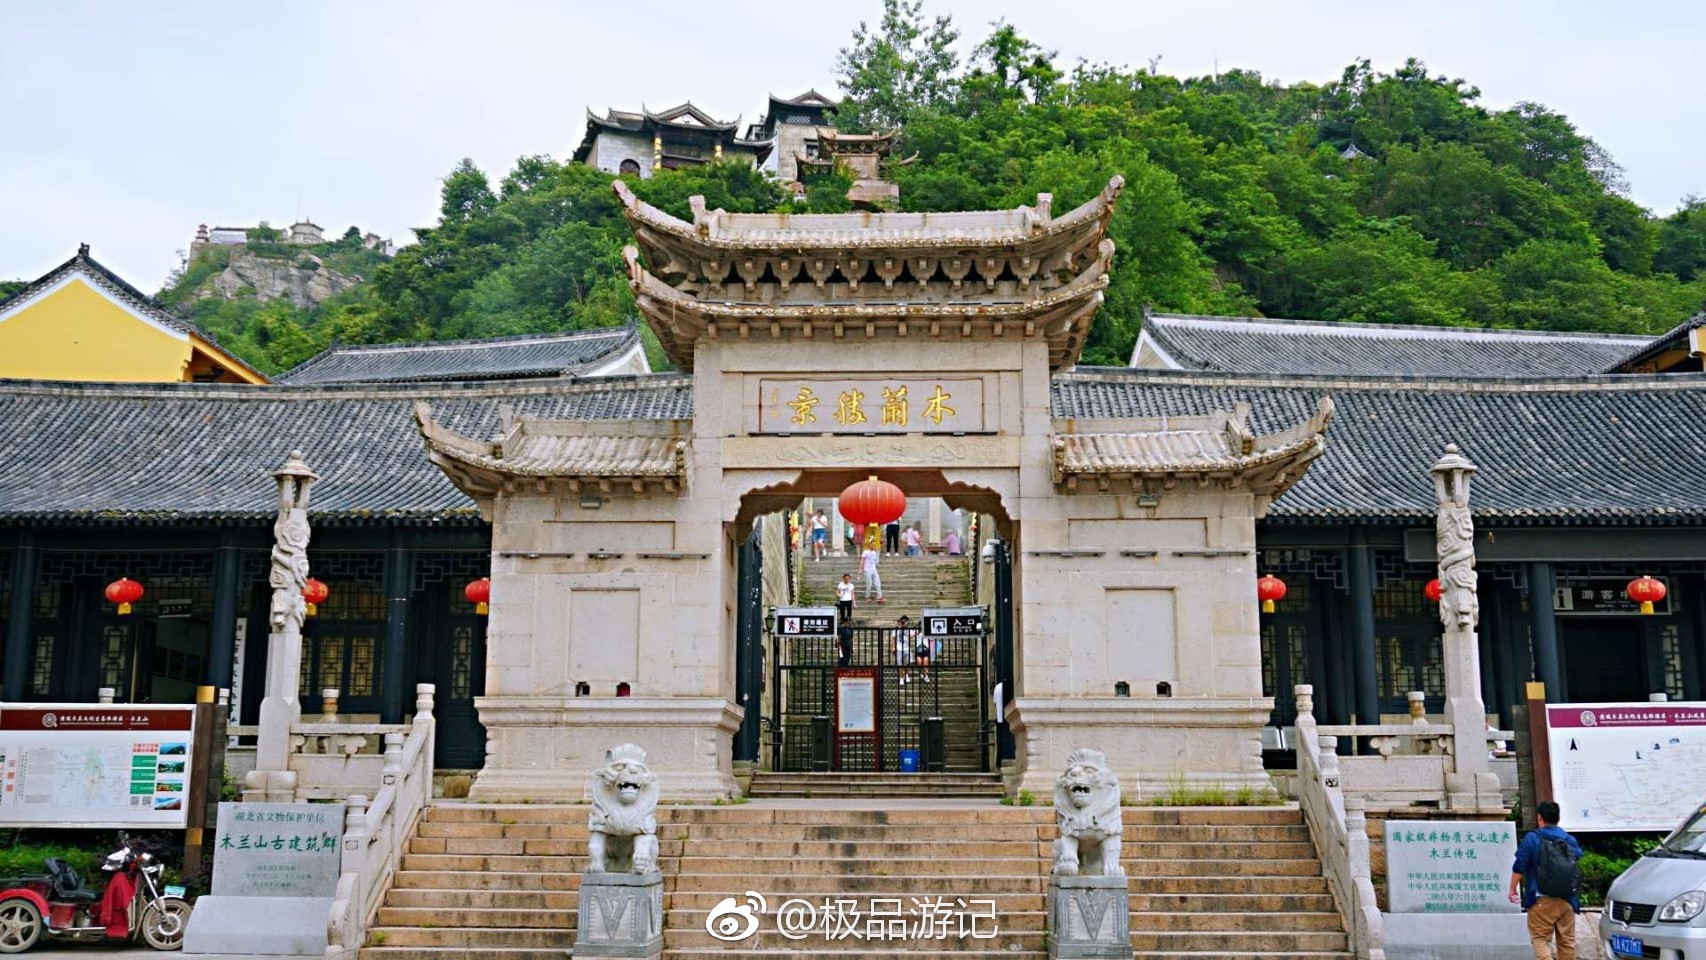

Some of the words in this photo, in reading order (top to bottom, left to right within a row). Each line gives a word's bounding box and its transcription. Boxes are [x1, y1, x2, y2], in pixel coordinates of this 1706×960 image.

[1581, 590, 1628, 600] 游客中
[235, 812, 325, 823] 湖北省文物保护单位
[220, 832, 338, 853] 木兰山古建筑群
[1392, 831, 1511, 843] 国家级非物质文化遗产
[1429, 848, 1477, 860] 木兰传说
[1407, 872, 1500, 881] 中华人民共和国国务院公布
